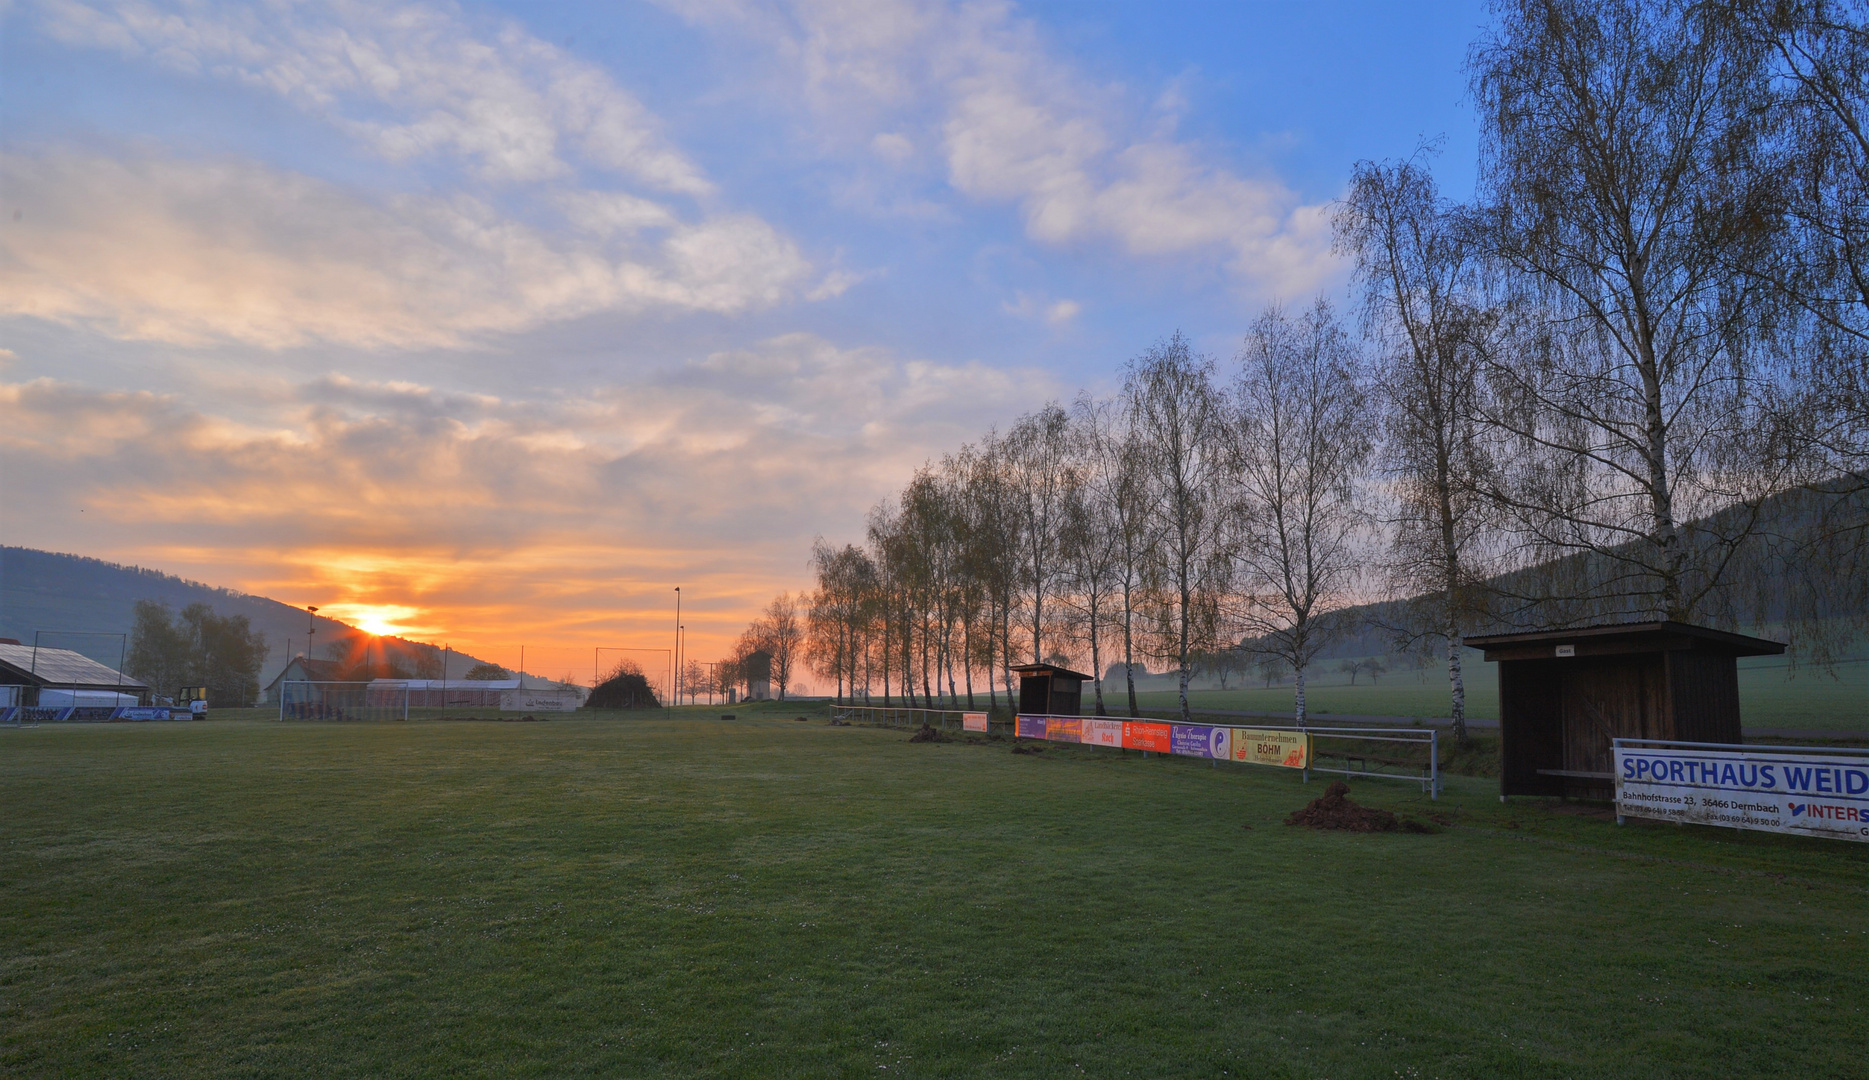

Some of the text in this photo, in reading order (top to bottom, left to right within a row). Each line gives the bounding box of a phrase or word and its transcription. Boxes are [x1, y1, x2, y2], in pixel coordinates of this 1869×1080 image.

[1133, 736, 1155, 748] Sparkasse
[1241, 730, 1297, 744] Bauunternehmen
[1257, 742, 1281, 756] BÖHM
[1623, 757, 1776, 788] SPORTHAUS
[1623, 791, 1780, 814] Bahnhofstrasse 23, 36466 Dermbach
[1771, 819, 1780, 827] 00
